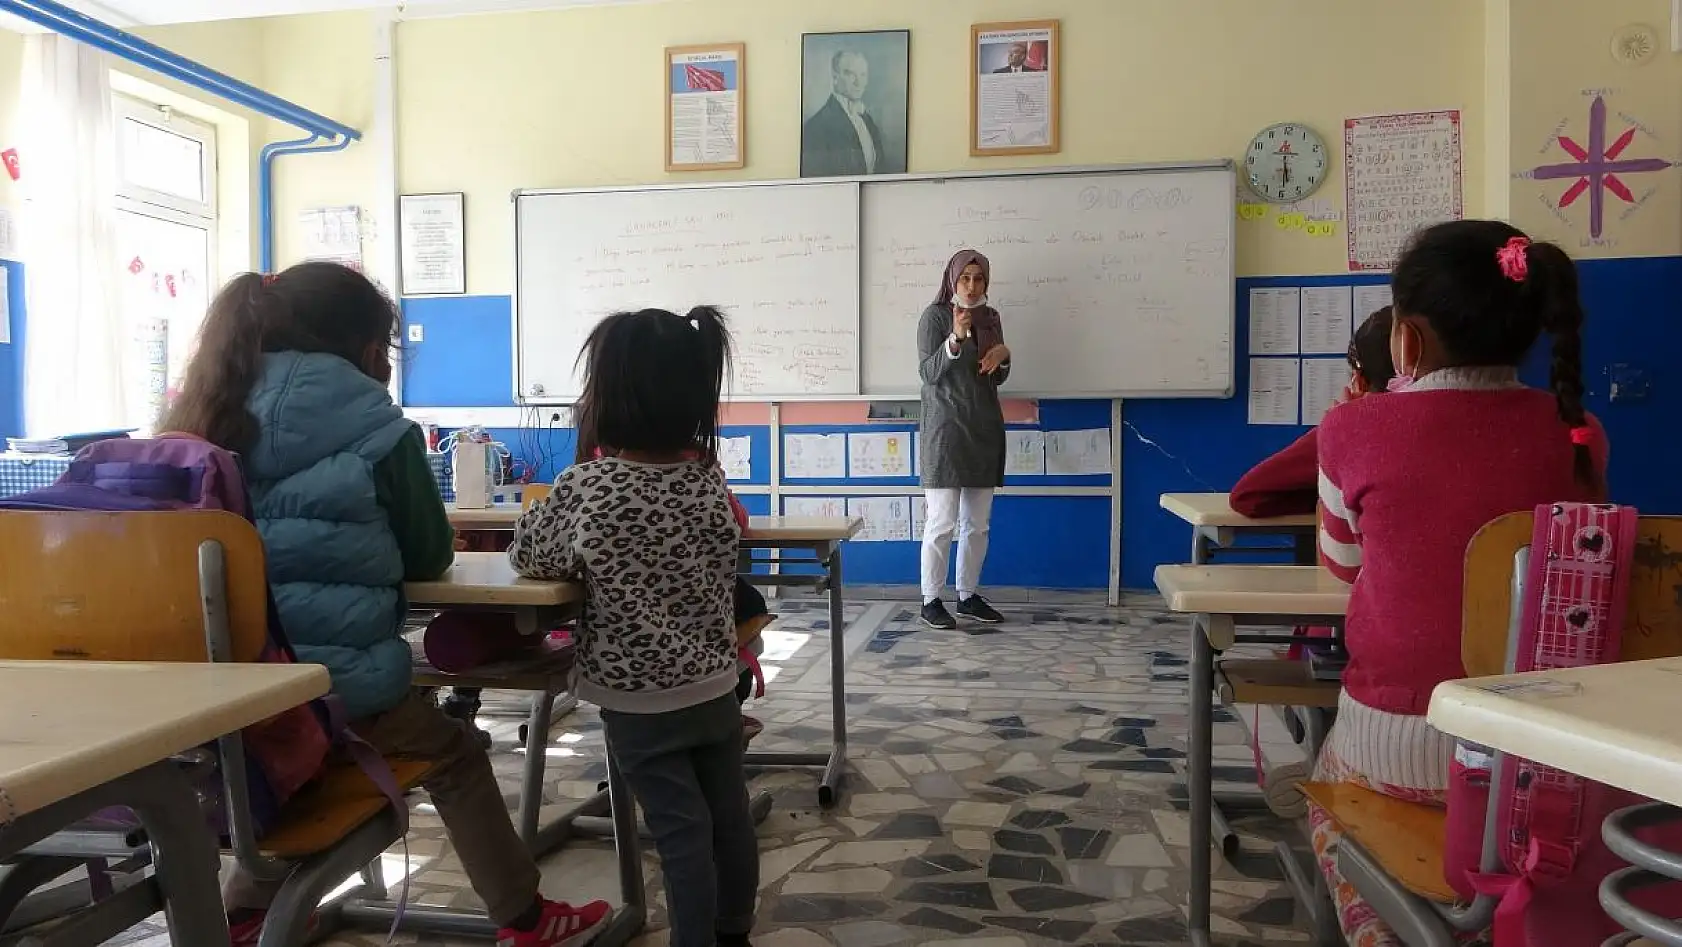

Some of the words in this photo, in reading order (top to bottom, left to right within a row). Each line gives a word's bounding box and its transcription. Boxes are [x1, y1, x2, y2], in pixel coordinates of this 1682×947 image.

[1284, 126, 1294, 136] 12
[1312, 144, 1321, 153] 2
[1315, 159, 1323, 168] 3
[1278, 190, 1284, 199] 6
